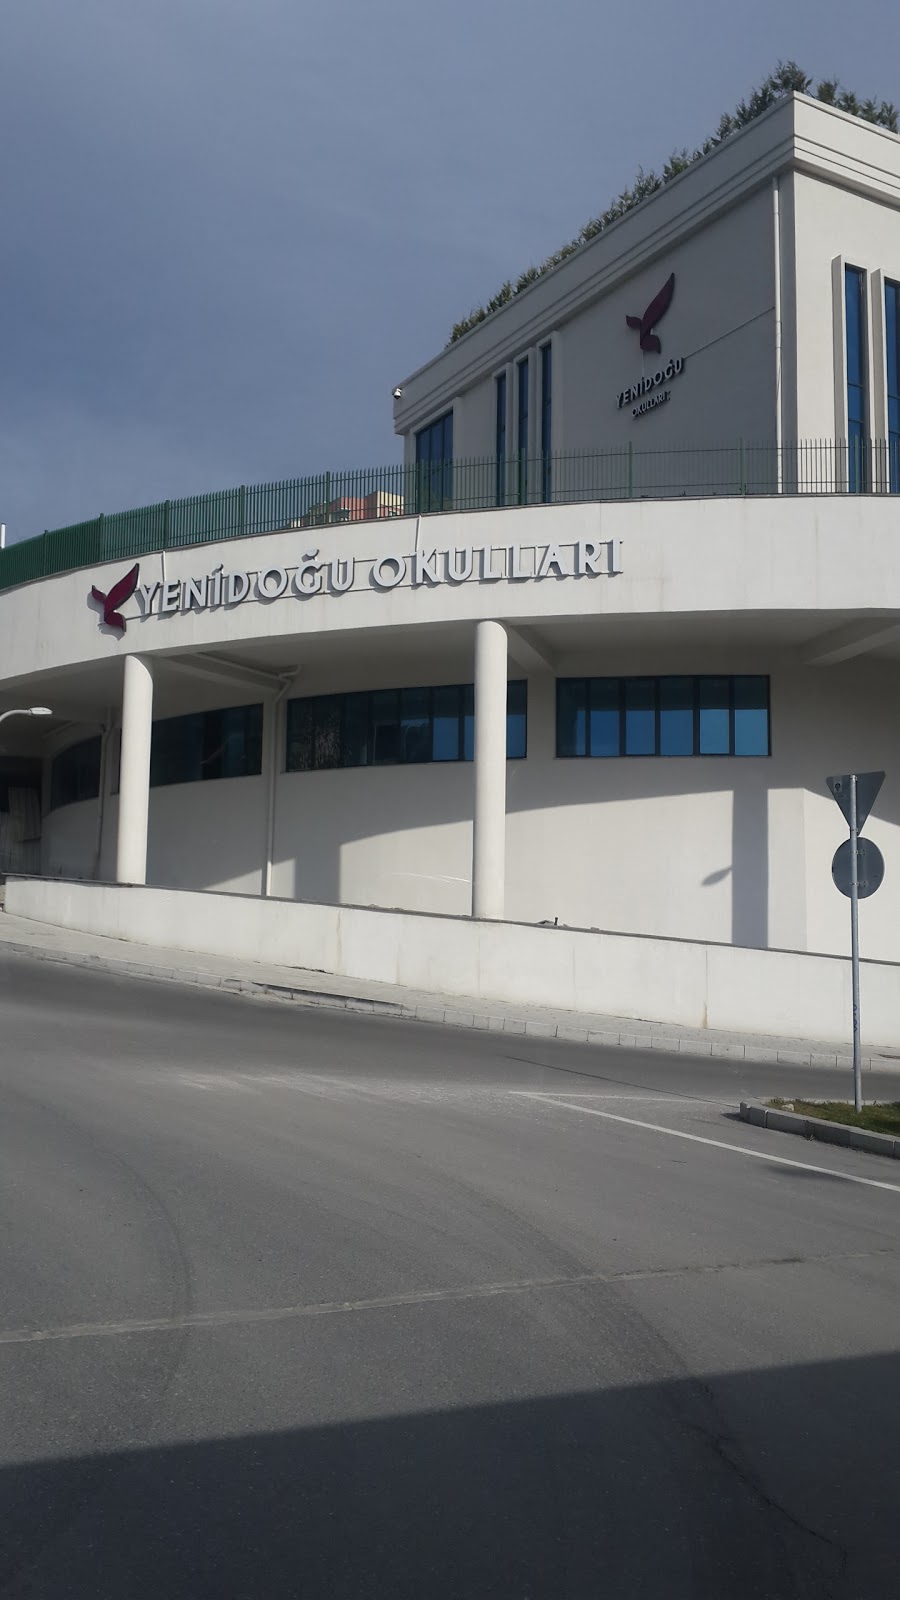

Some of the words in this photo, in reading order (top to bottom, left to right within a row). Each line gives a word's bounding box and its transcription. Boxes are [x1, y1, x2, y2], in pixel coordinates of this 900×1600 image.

[616, 357, 685, 409] YENİDOĞU
[631, 390, 669, 417] OKULLARI
[139, 549, 354, 614] YENİDOĞU
[372, 538, 622, 588] OKULLARI
